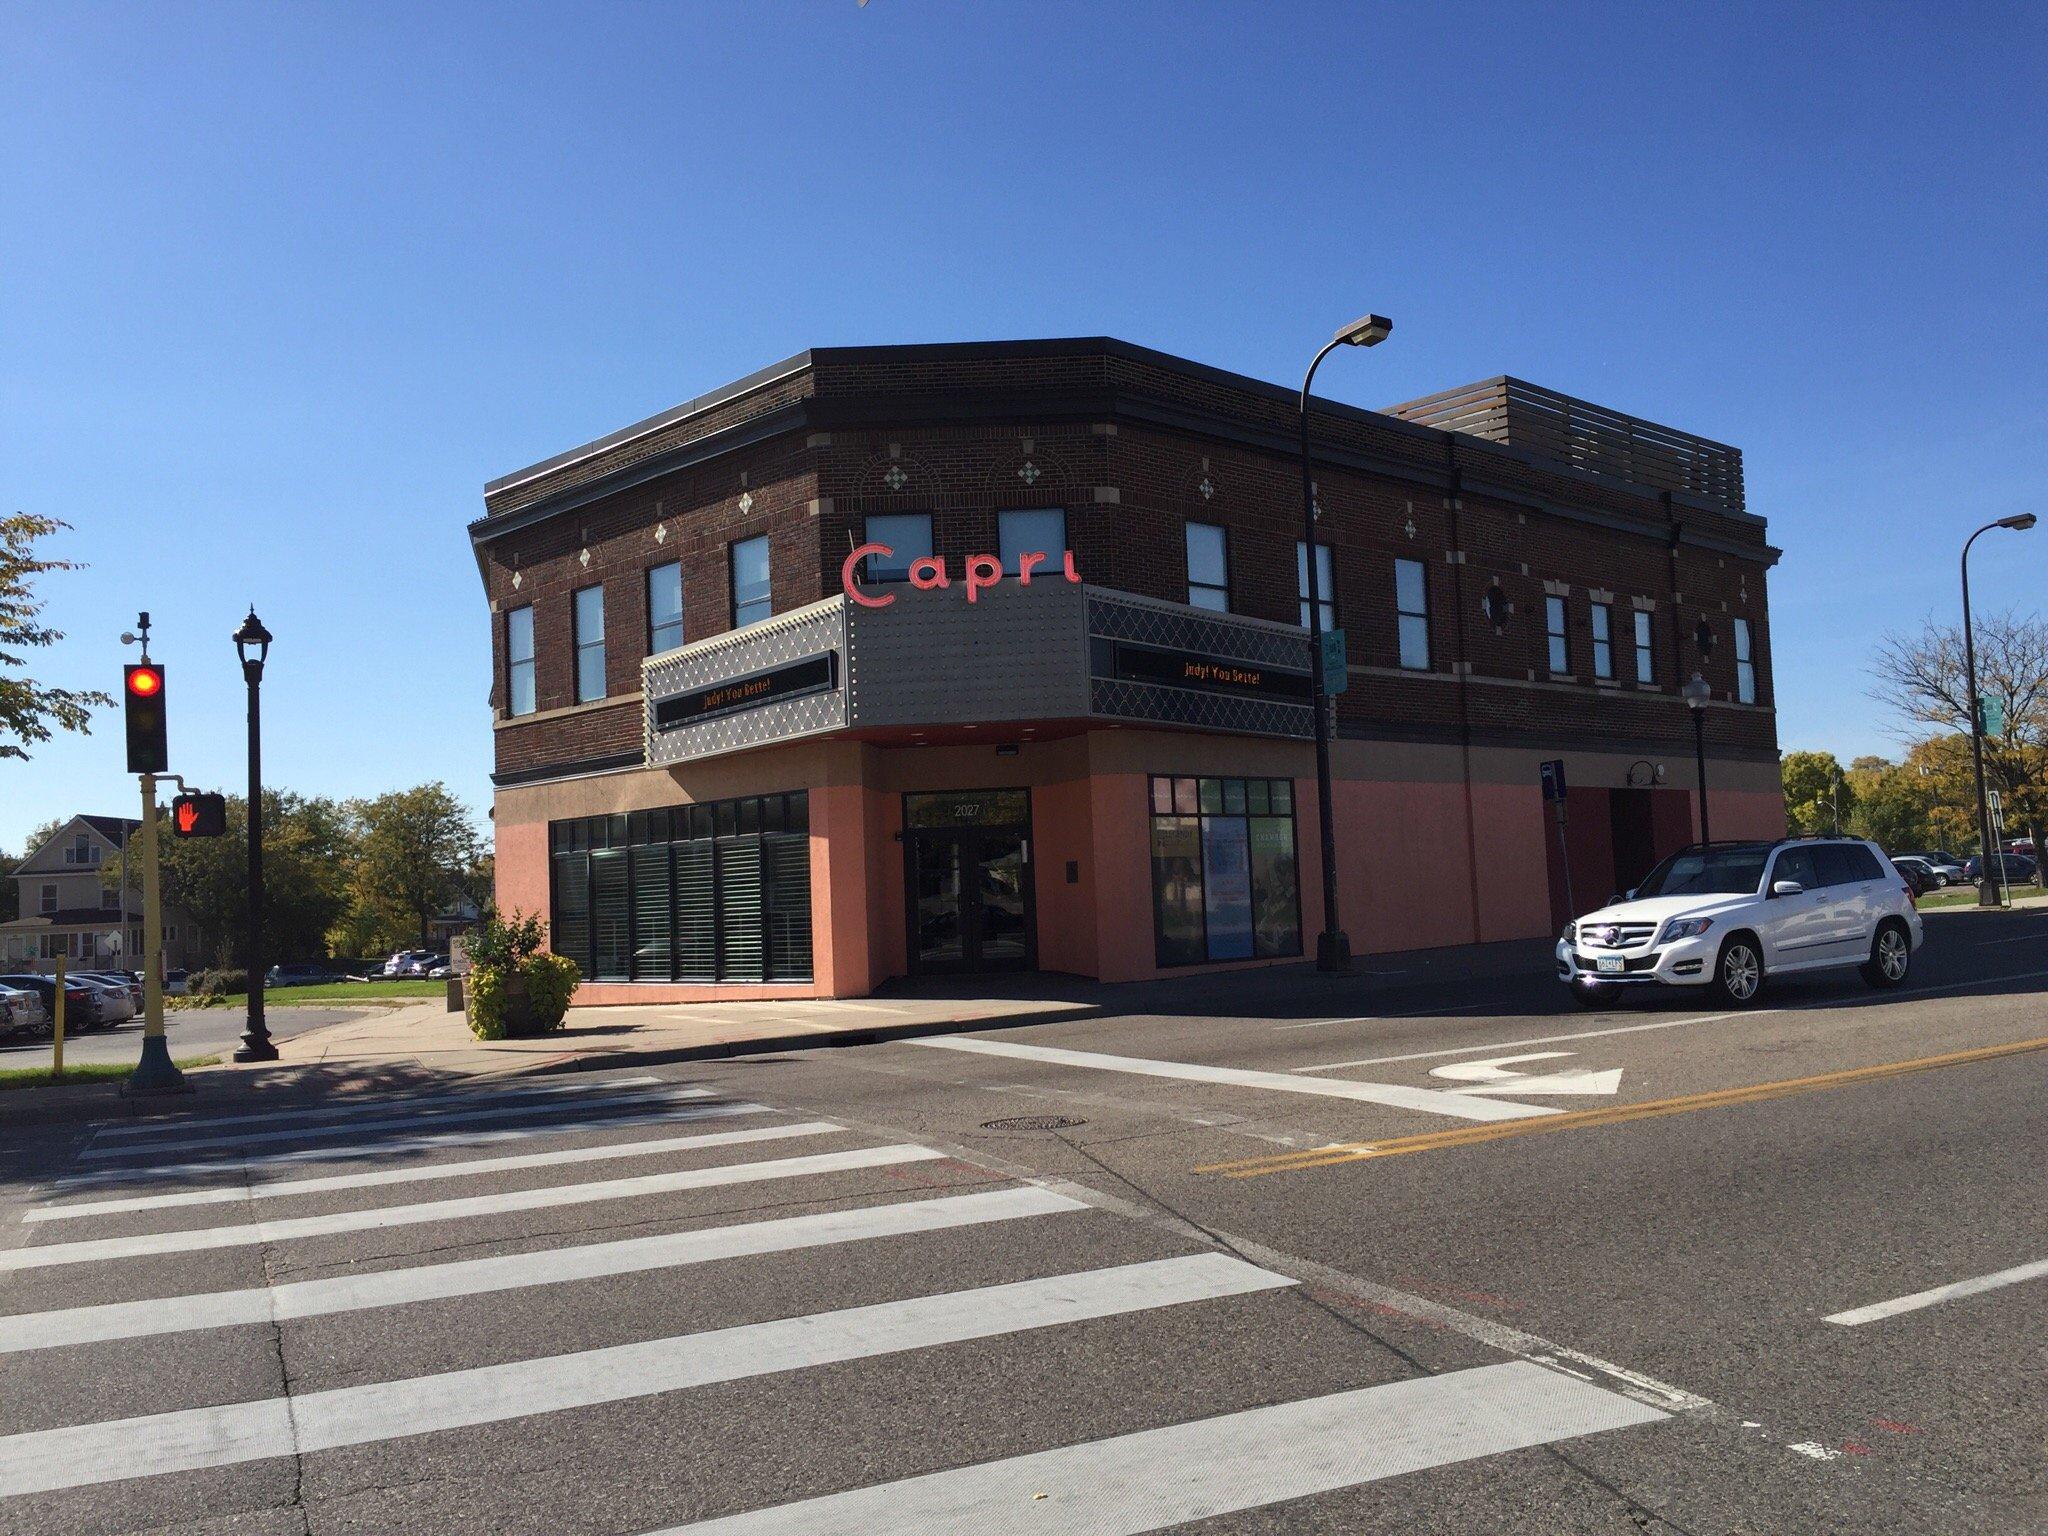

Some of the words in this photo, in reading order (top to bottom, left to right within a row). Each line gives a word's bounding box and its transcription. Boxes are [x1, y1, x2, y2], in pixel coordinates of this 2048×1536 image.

[842, 543, 1082, 608] Capri
[1184, 662, 1209, 679] Judy!
[1211, 666, 1231, 681] You
[726, 687, 742, 701] You
[955, 804, 979, 817] 2027
